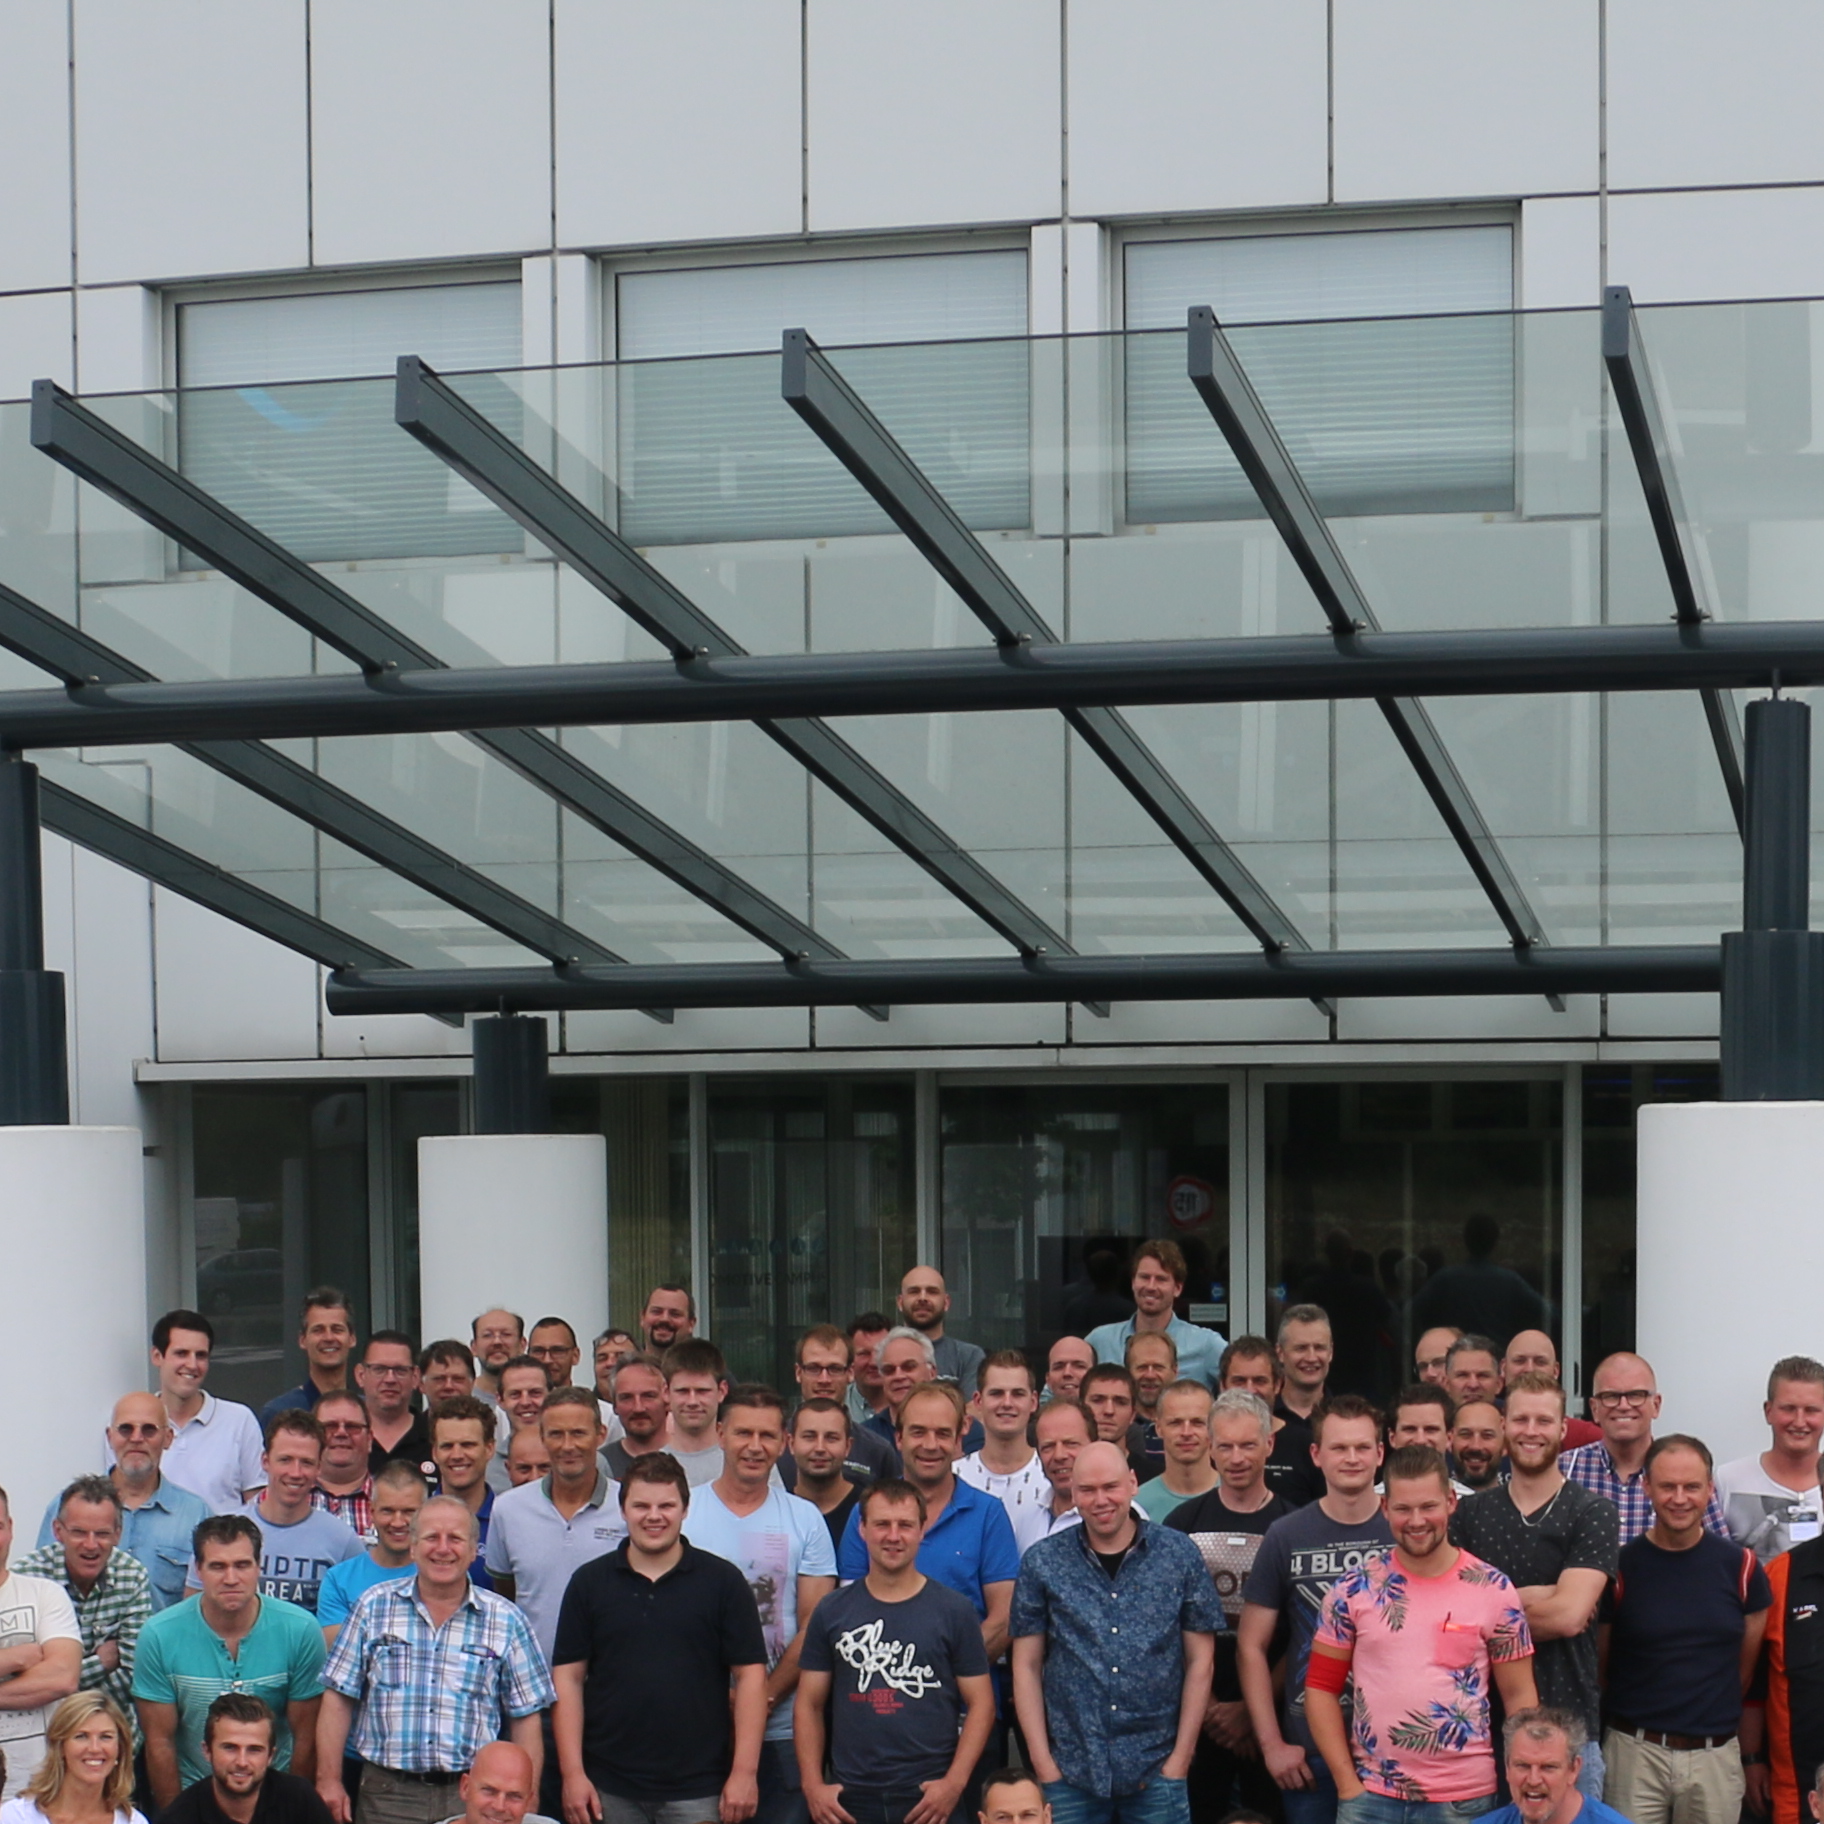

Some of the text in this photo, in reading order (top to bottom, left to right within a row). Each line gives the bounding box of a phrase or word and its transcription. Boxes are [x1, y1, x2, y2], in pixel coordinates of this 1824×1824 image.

[1310, 1549, 1388, 1574] BLO
[835, 1618, 904, 1669] Blue
[858, 1643, 943, 1698] Ridge
